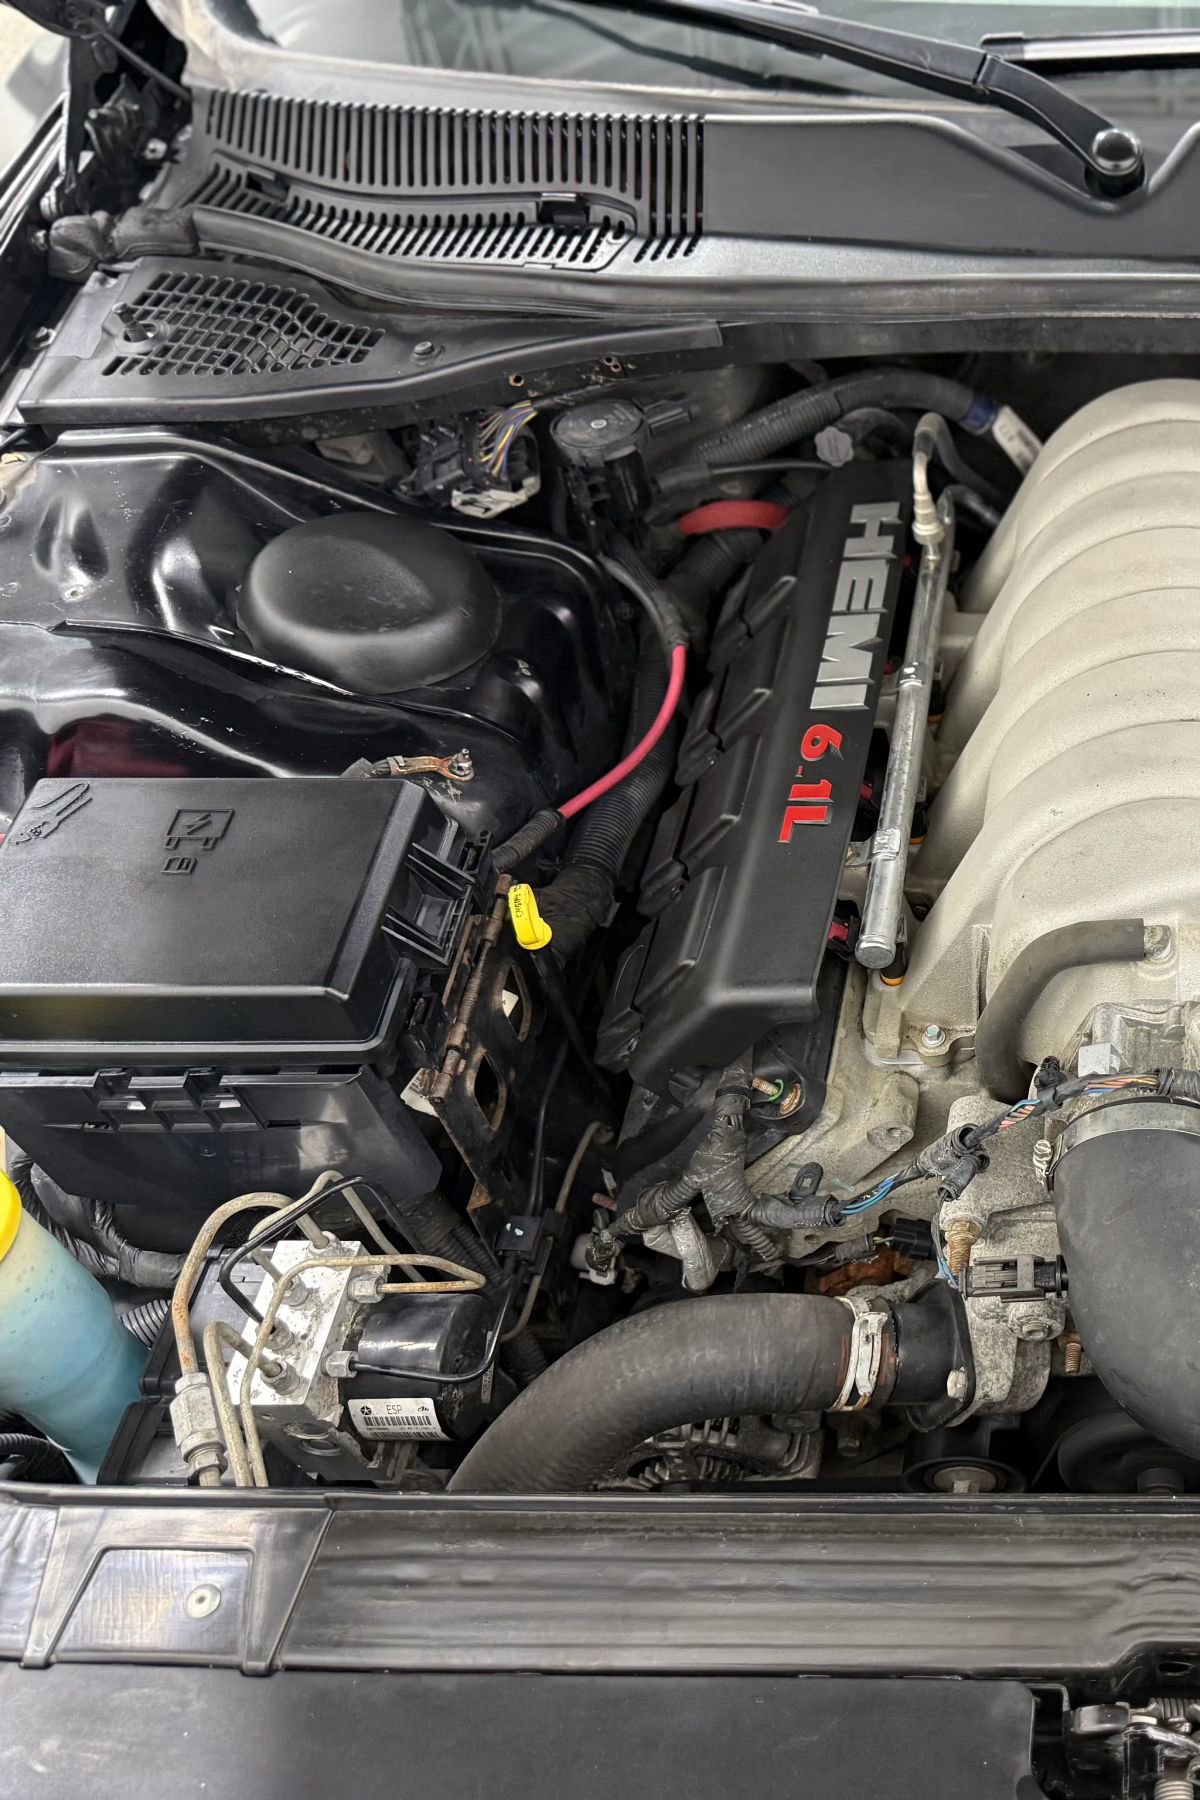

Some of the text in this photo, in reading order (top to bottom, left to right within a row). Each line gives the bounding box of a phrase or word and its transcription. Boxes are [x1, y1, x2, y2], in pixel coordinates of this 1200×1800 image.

[809, 501, 902, 710] HEMI
[777, 723, 844, 844] 6.1L
[386, 1404, 403, 1415] ESP
